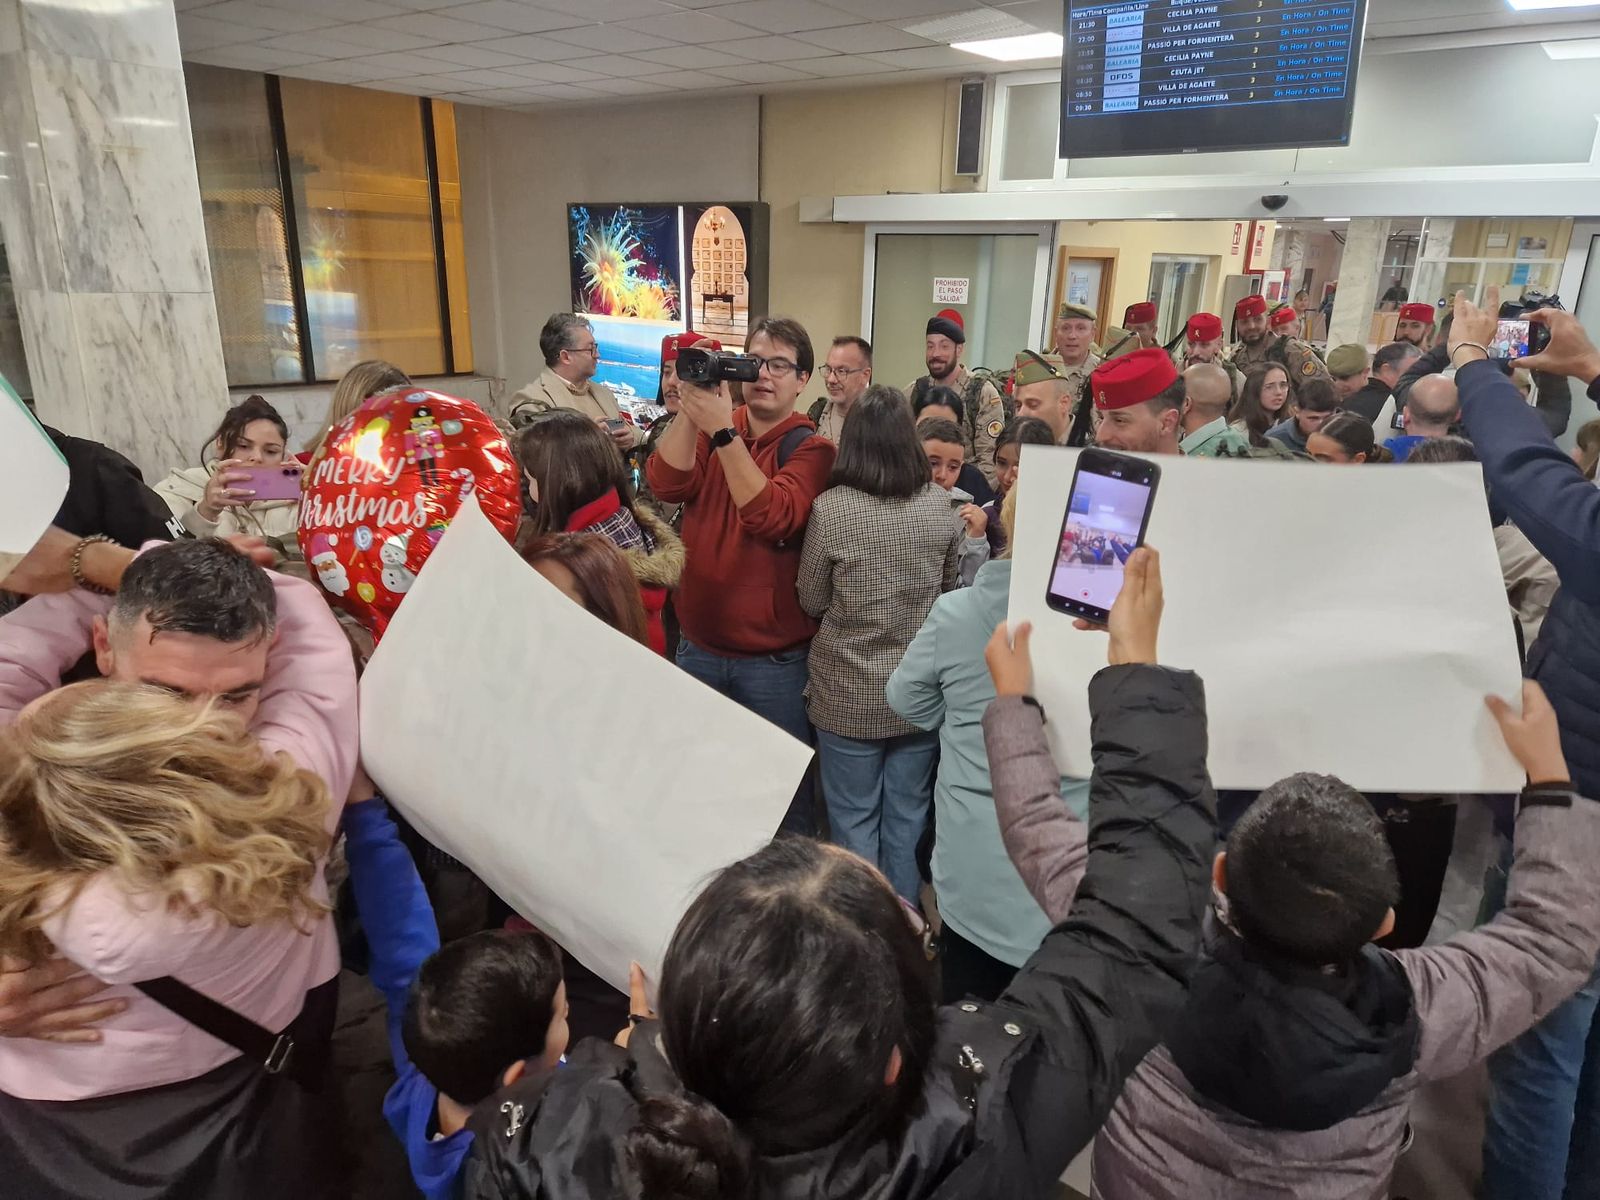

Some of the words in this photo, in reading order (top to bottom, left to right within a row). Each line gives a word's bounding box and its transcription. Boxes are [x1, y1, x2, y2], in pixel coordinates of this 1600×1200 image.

[1167, 9, 1193, 18] CECILIA
[1195, 6, 1218, 15] PAYNE
[1257, 0, 1262, 8] 3
[1162, 25, 1181, 33] VILLA
[1193, 21, 1221, 30] AGAETE
[1332, 7, 1350, 15] Time
[1172, 39, 1186, 47] PER
[1187, 34, 1234, 45] FORMENTERA
[1164, 53, 1189, 62] CECILIA
[1191, 51, 1214, 59] PAYNE
[1110, 72, 1133, 81] DFDS
[1170, 67, 1192, 76] CEUTA
[1194, 66, 1205, 75] JET
[1158, 83, 1176, 91] VILLA
[1189, 80, 1216, 88] AGAETE
[1250, 76, 1255, 84] 3
[1183, 94, 1229, 103] FORMENTERA
[313, 455, 405, 486] MERRY
